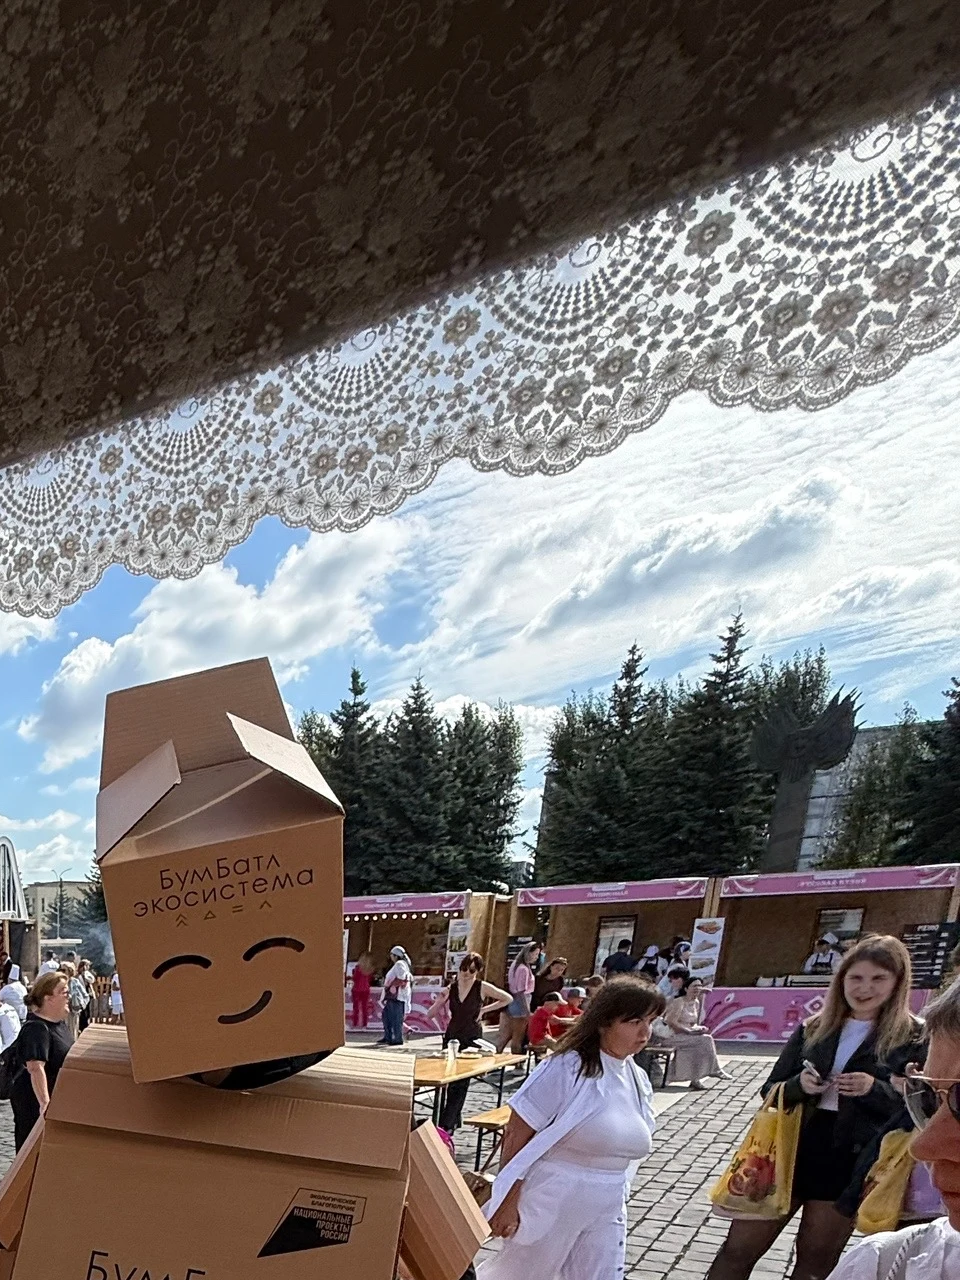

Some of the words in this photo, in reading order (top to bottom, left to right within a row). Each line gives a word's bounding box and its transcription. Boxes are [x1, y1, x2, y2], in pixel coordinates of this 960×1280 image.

[159, 854, 282, 892] БумБатл
[133, 867, 314, 918] экосистема
[293, 1208, 352, 1225] НАЦИОНАЛЬНЫЕ
[315, 1219, 351, 1233] ПРОЕКТЫ
[319, 1229, 349, 1242] РОССИИ
